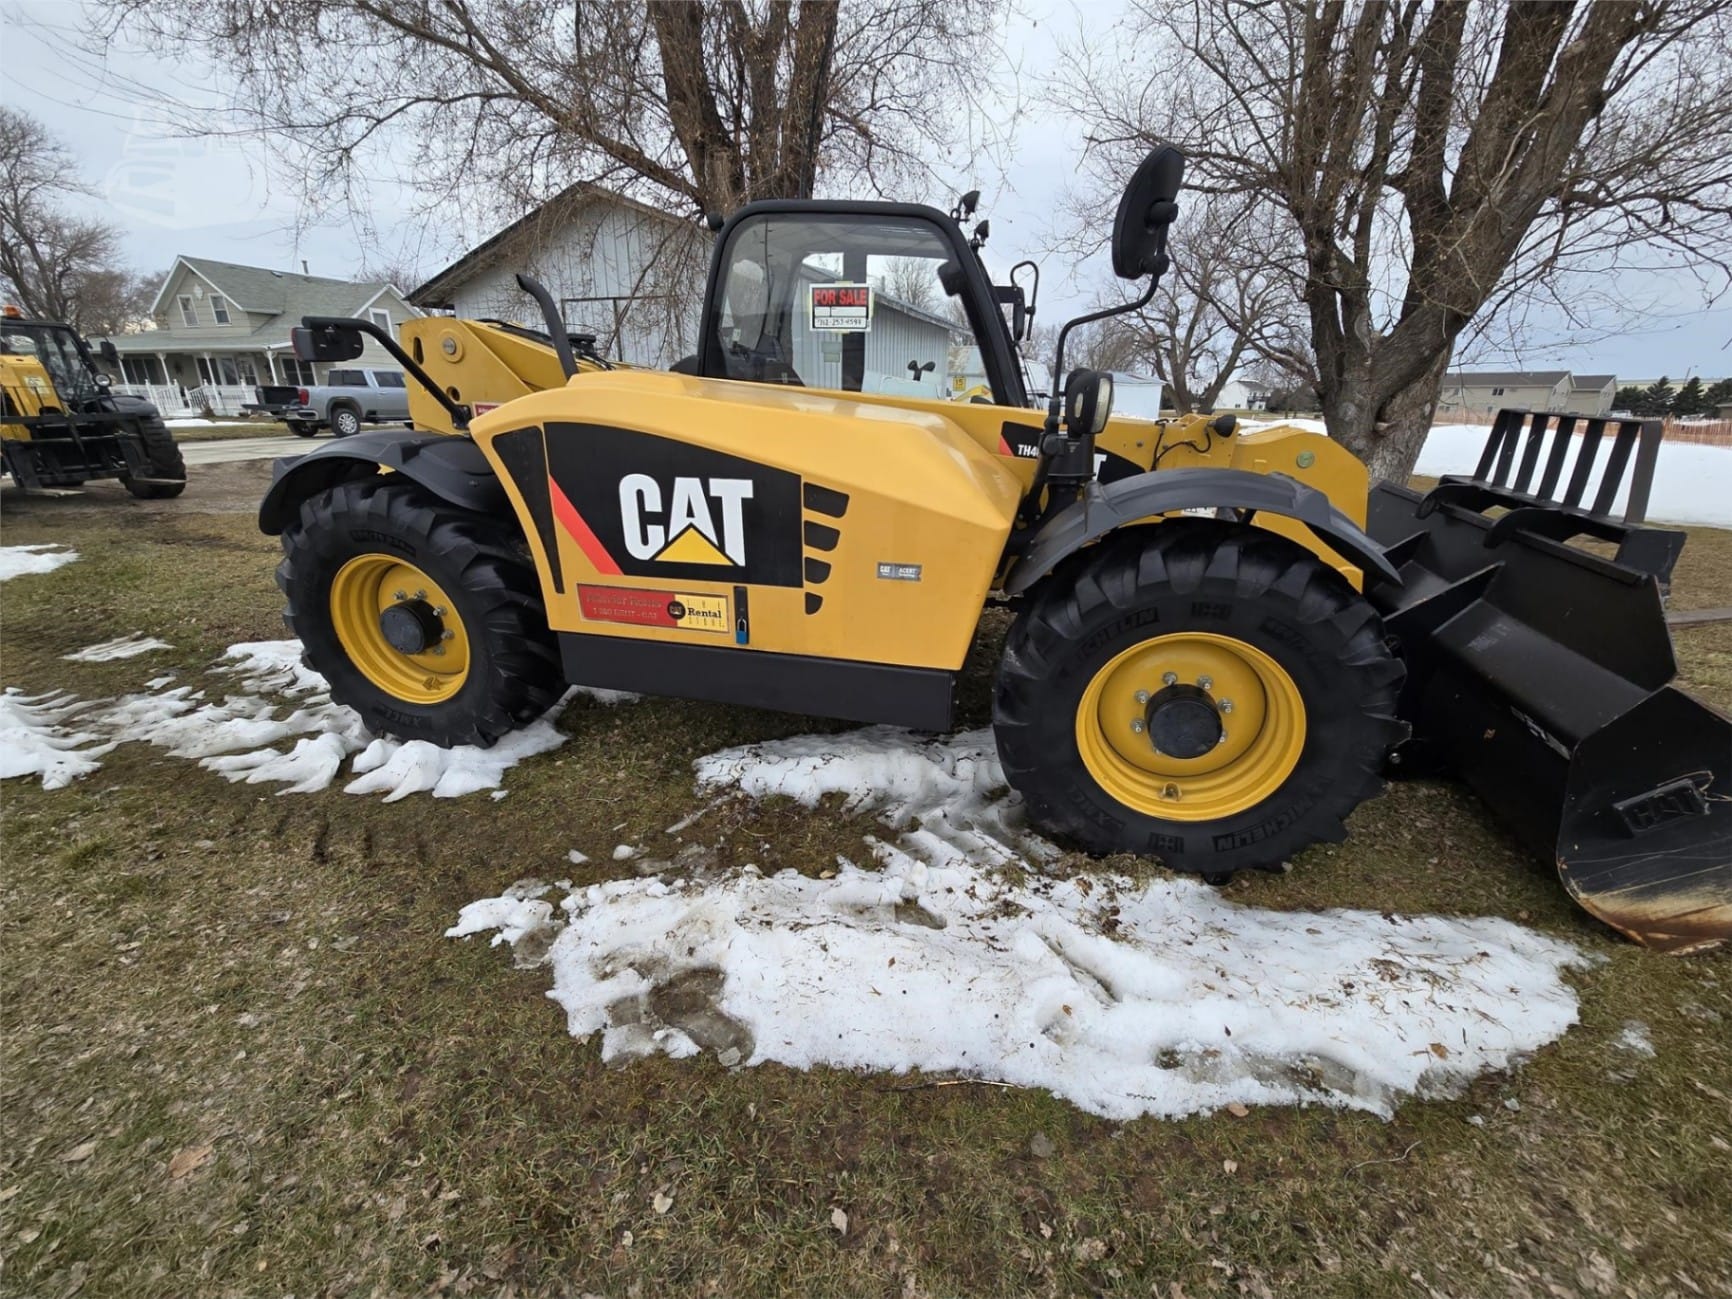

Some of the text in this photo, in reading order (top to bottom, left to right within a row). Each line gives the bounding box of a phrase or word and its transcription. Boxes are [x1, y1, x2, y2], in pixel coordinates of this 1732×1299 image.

[814, 288, 867, 305] FOR SALE
[1017, 443, 1040, 457] TH4
[619, 473, 754, 567] CAT
[687, 607, 722, 619] Rental
